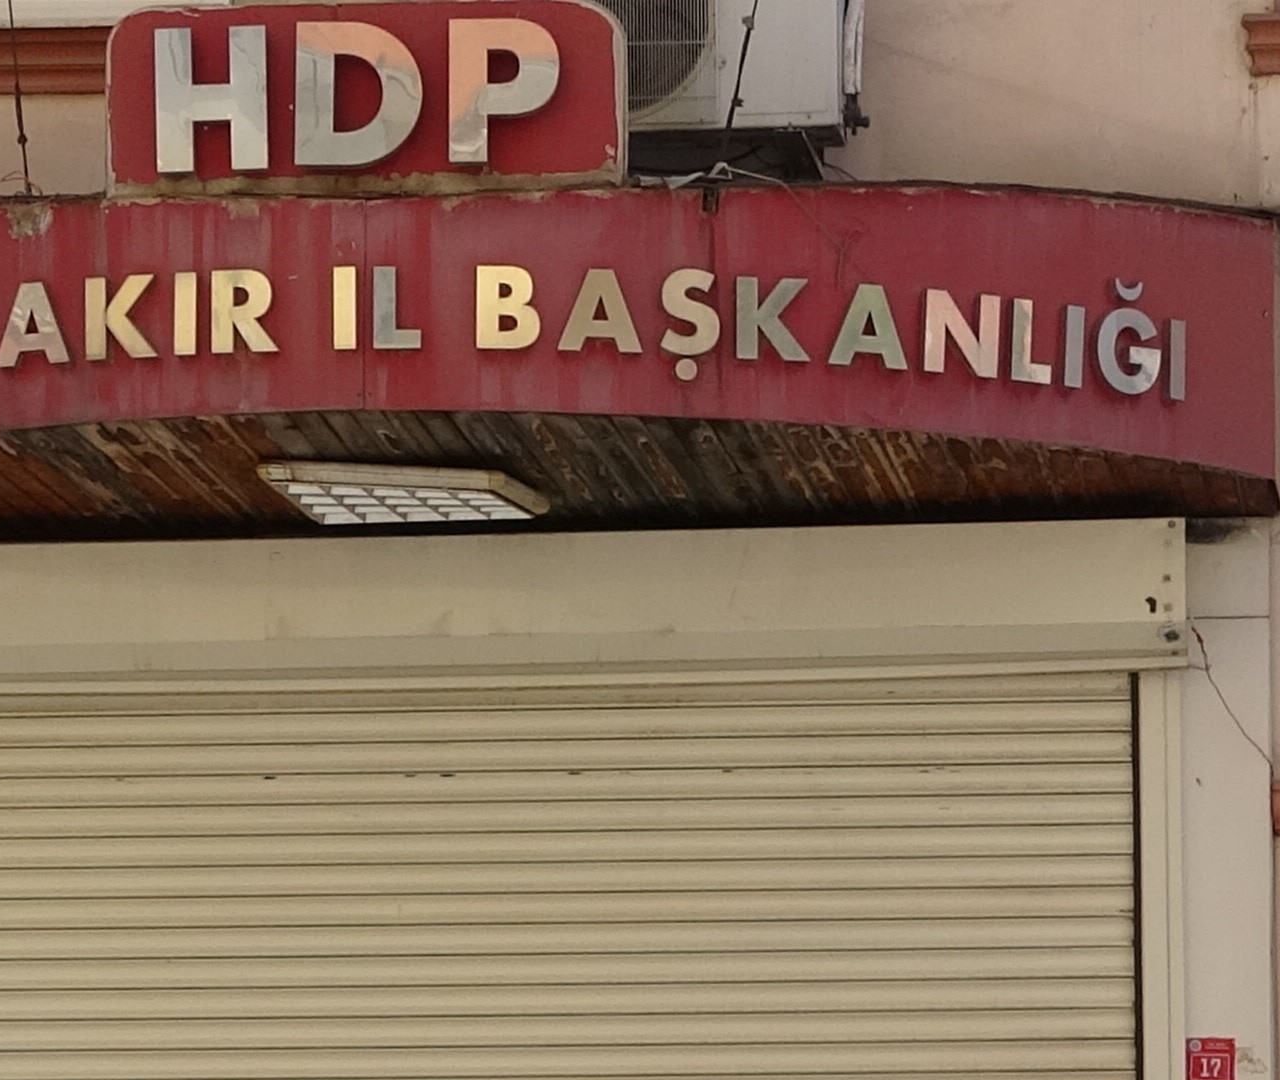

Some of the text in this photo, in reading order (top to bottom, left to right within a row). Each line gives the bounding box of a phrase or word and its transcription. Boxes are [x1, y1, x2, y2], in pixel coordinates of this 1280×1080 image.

[154, 18, 560, 172] HDP
[475, 264, 1187, 402] BAŞKANLIĞI
[1200, 1058, 1222, 1078] 17
